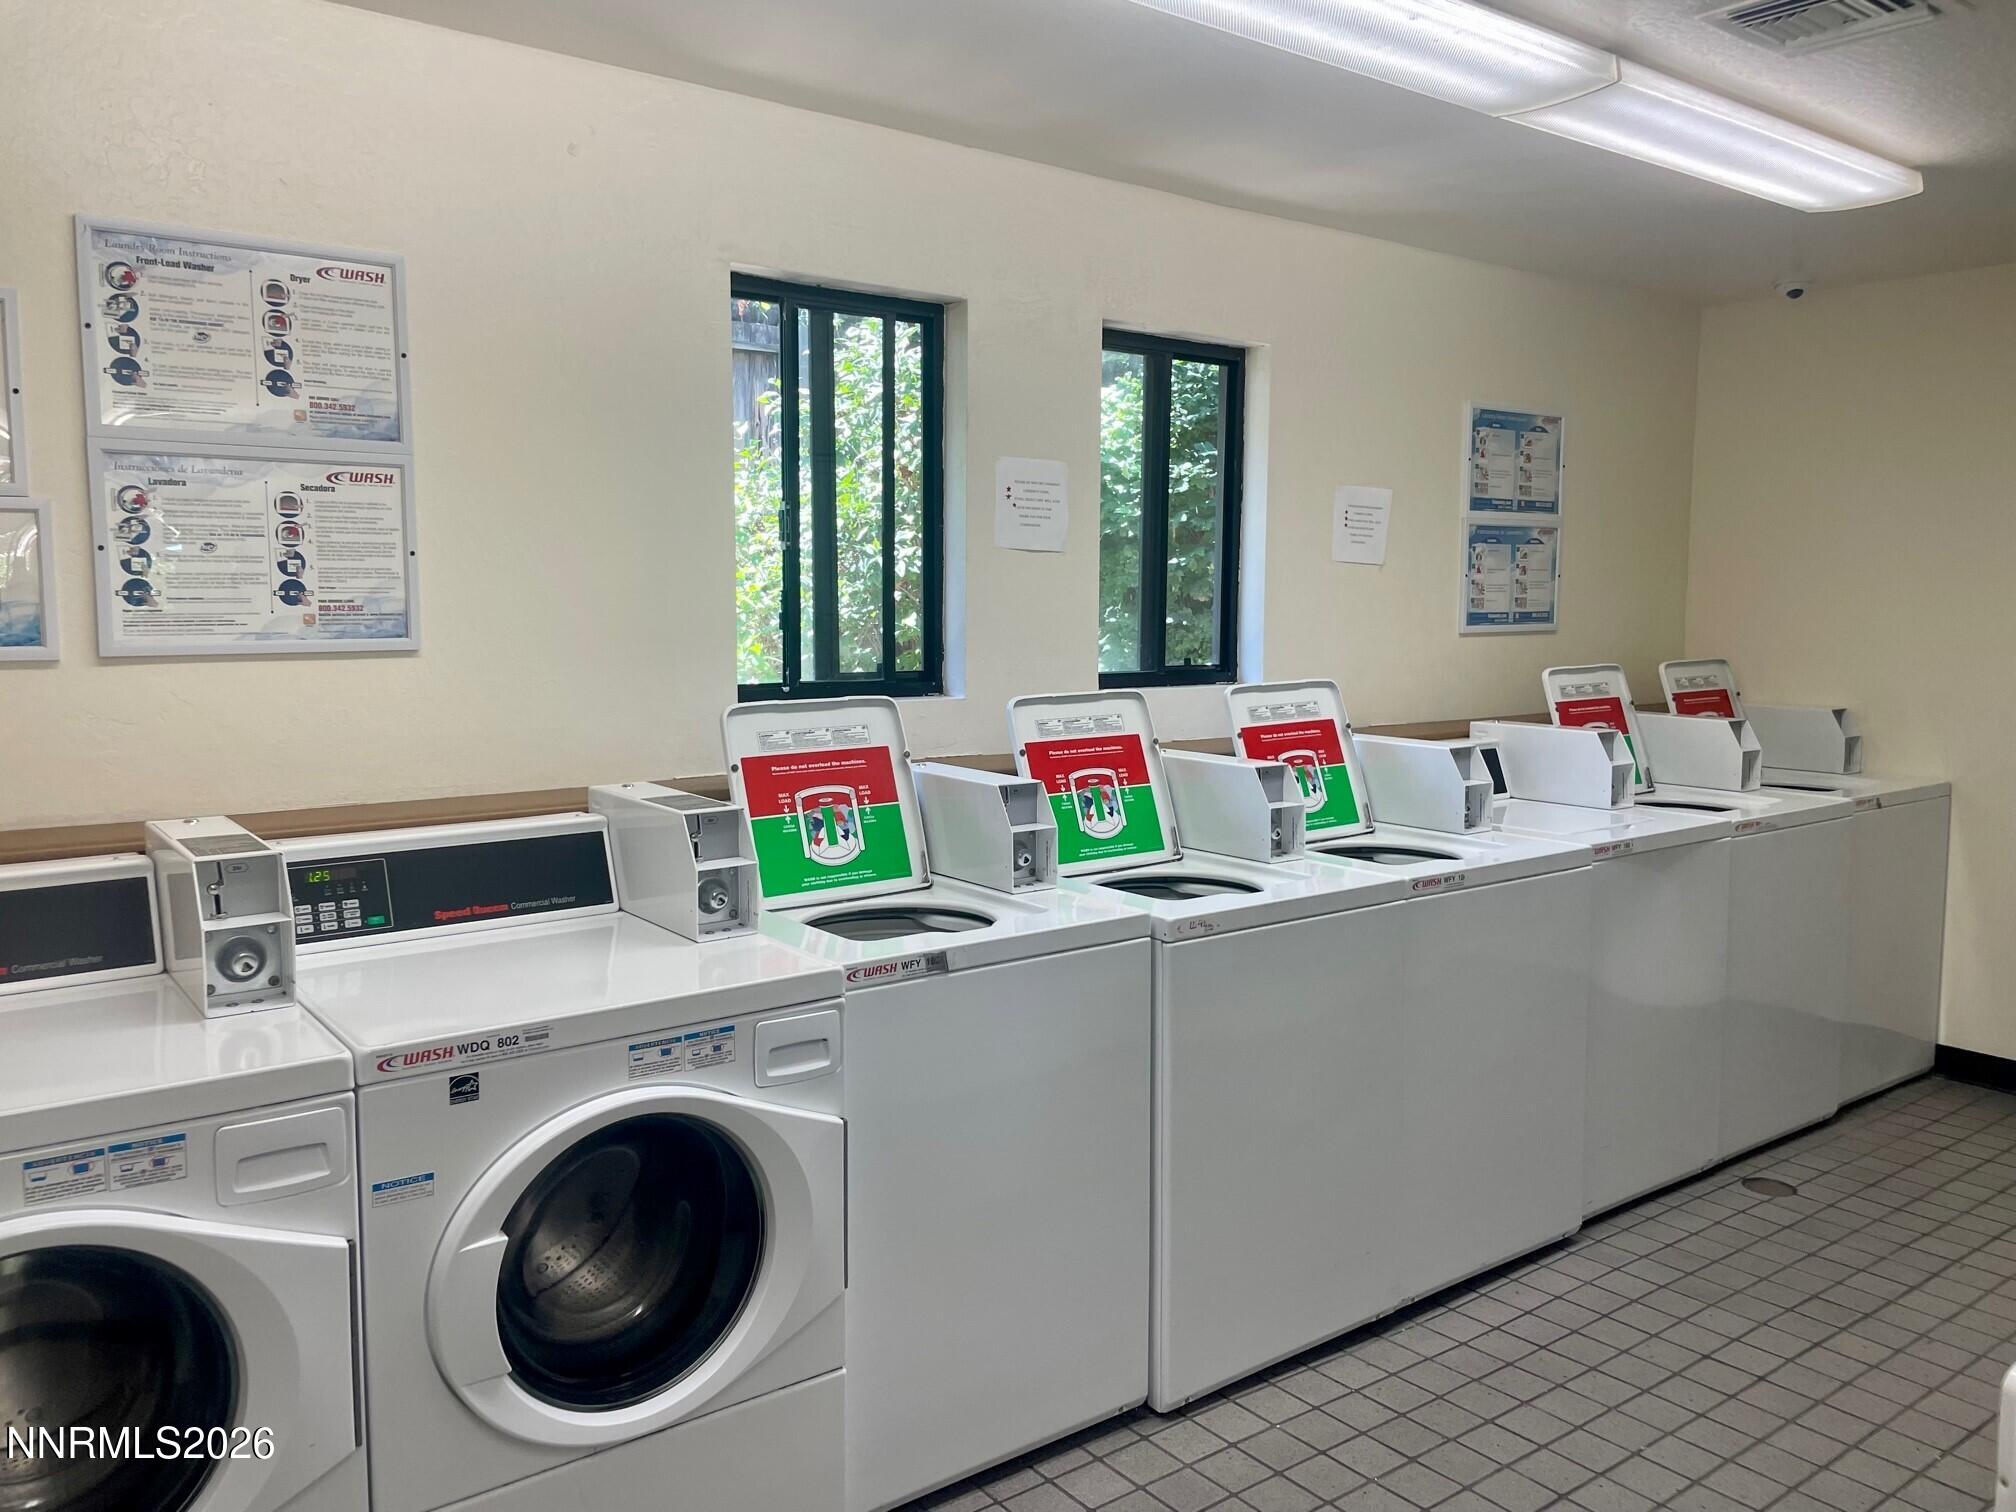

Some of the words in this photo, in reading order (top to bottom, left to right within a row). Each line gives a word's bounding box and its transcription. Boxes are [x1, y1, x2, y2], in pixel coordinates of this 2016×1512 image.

[136, 256, 180, 268] Front-Load
[183, 262, 214, 272] Washer
[290, 274, 310, 284] Dryer
[340, 269, 384, 283] WASH
[148, 478, 186, 486] Lavadora
[350, 473, 394, 484] WASH
[300, 484, 335, 492] Secadora
[434, 907, 471, 920] Speed
[511, 898, 550, 909] Commercial
[551, 896, 575, 904] Washer
[864, 963, 897, 977] WASH
[901, 959, 921, 970] WFY
[403, 1046, 454, 1066] WASH
[457, 1040, 489, 1055] WDQ
[498, 1035, 519, 1048] 802
[381, 1176, 426, 1189] NOTICE
